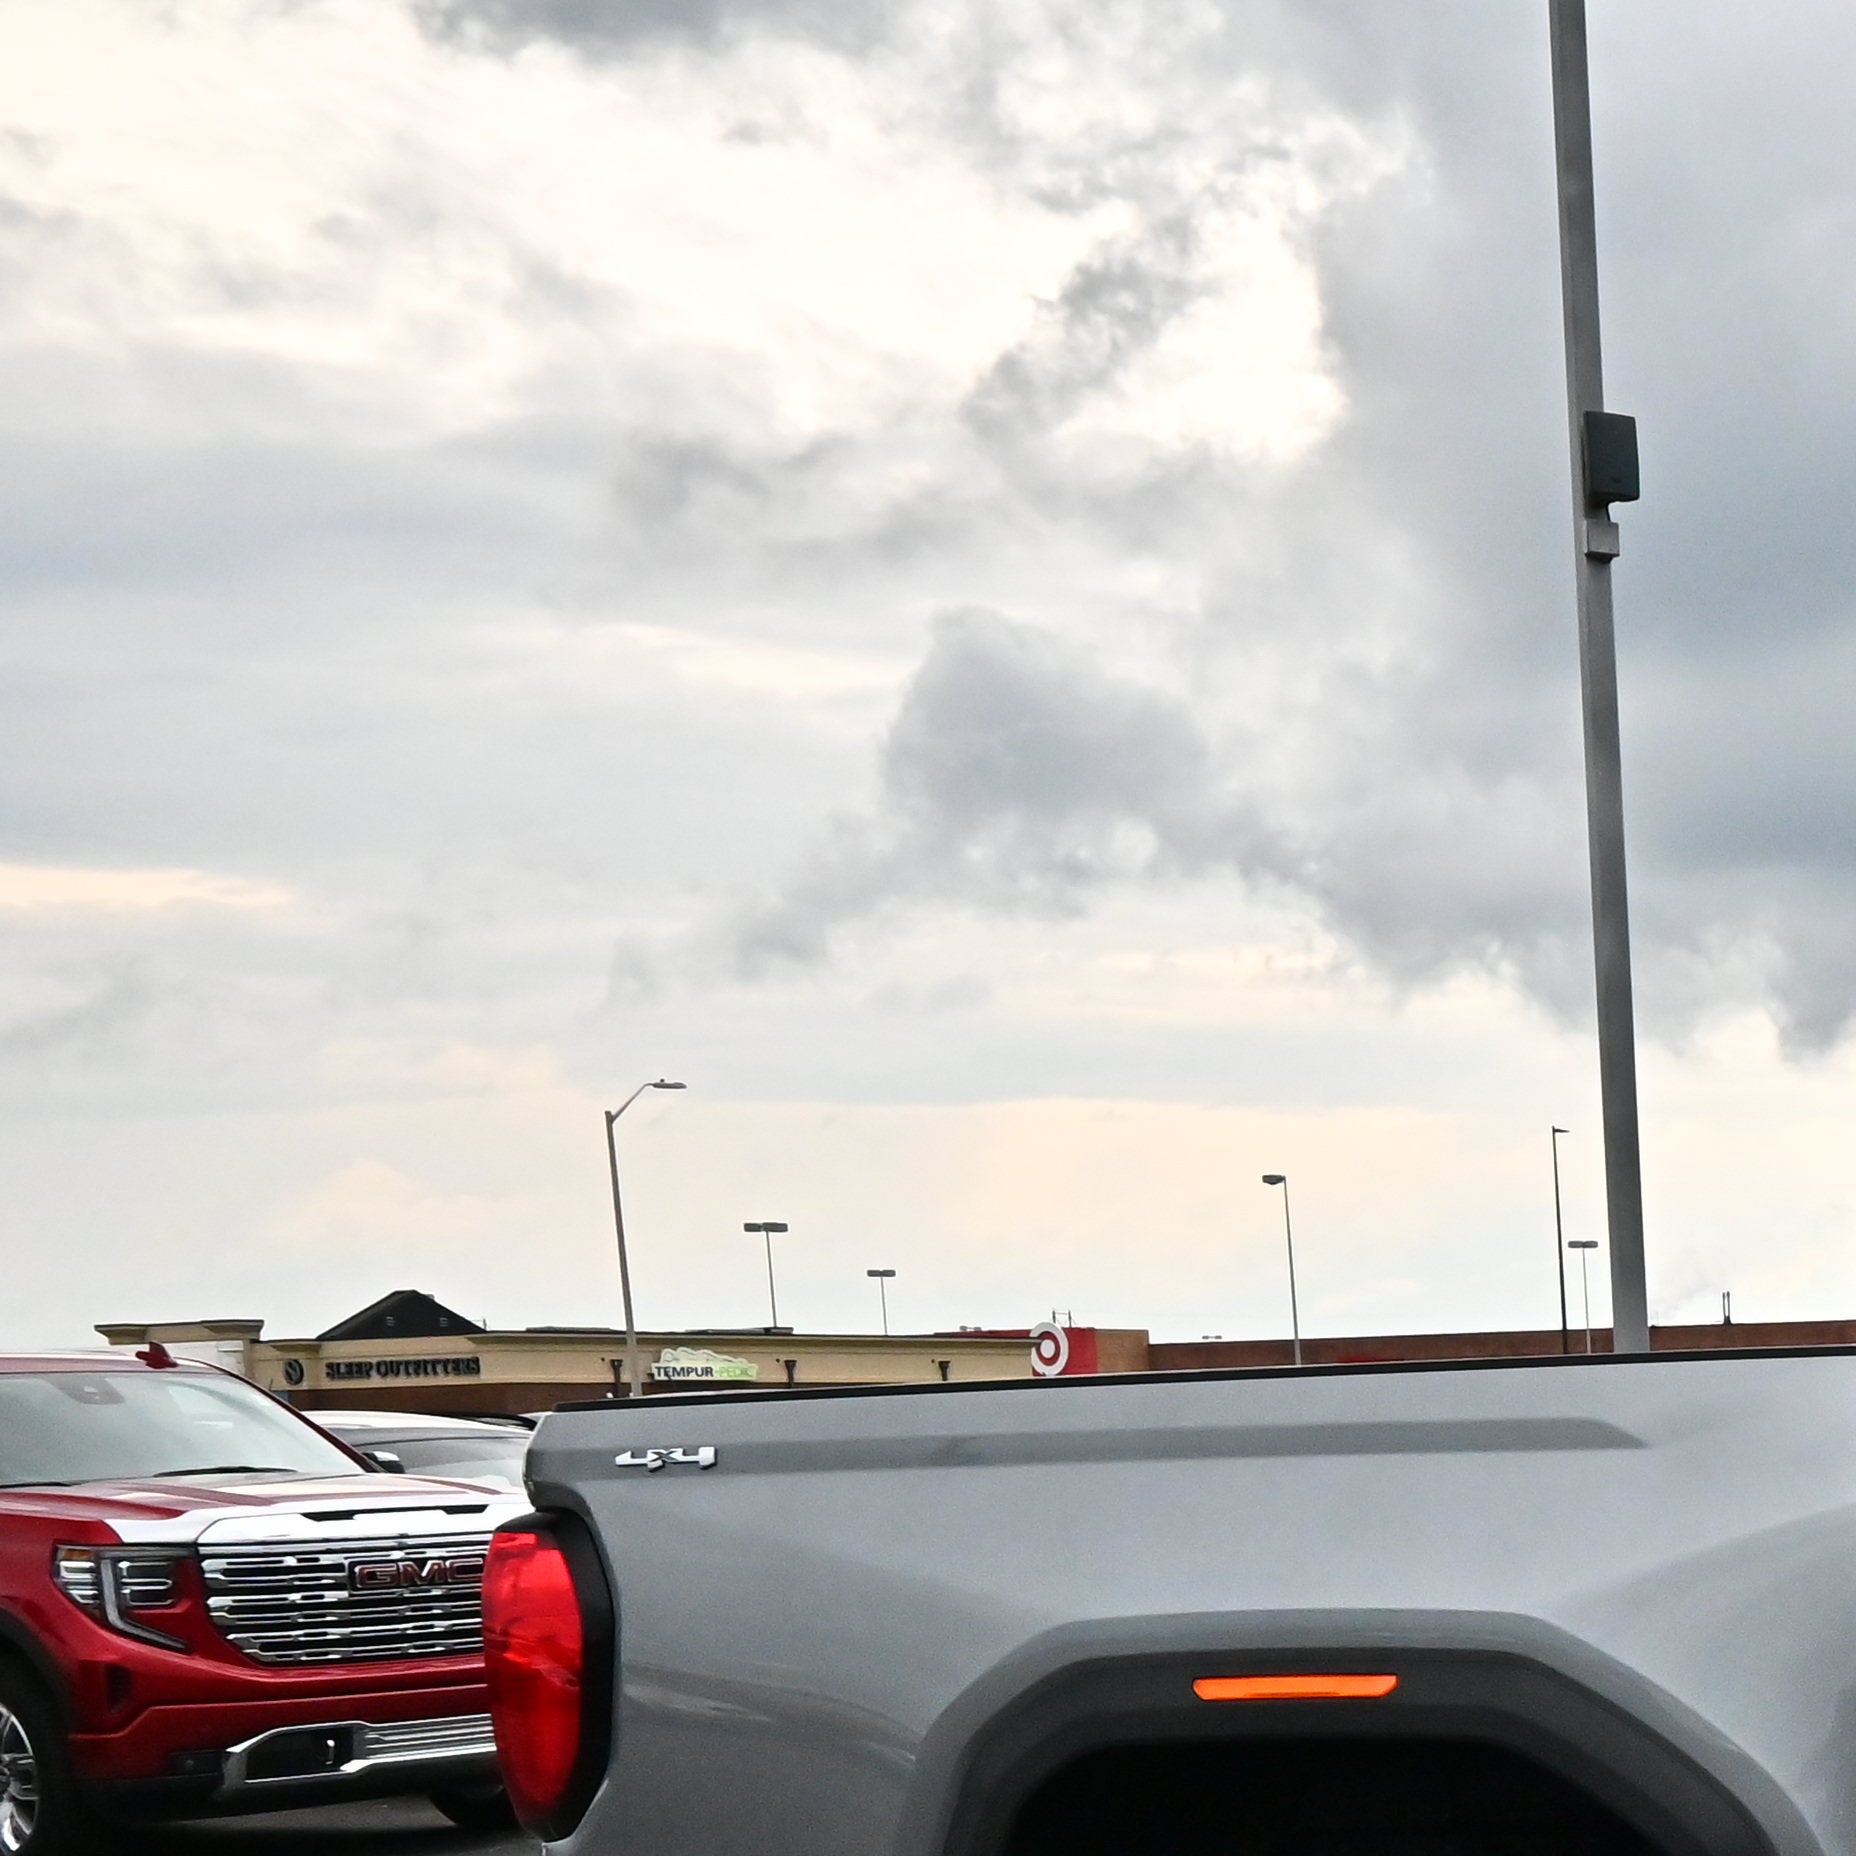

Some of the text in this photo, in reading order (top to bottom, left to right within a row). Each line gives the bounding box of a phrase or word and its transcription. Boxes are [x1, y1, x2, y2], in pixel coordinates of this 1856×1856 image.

[325, 1356, 480, 1380] SLEEP OUTFITTERS
[354, 1558, 485, 1588] GMC
